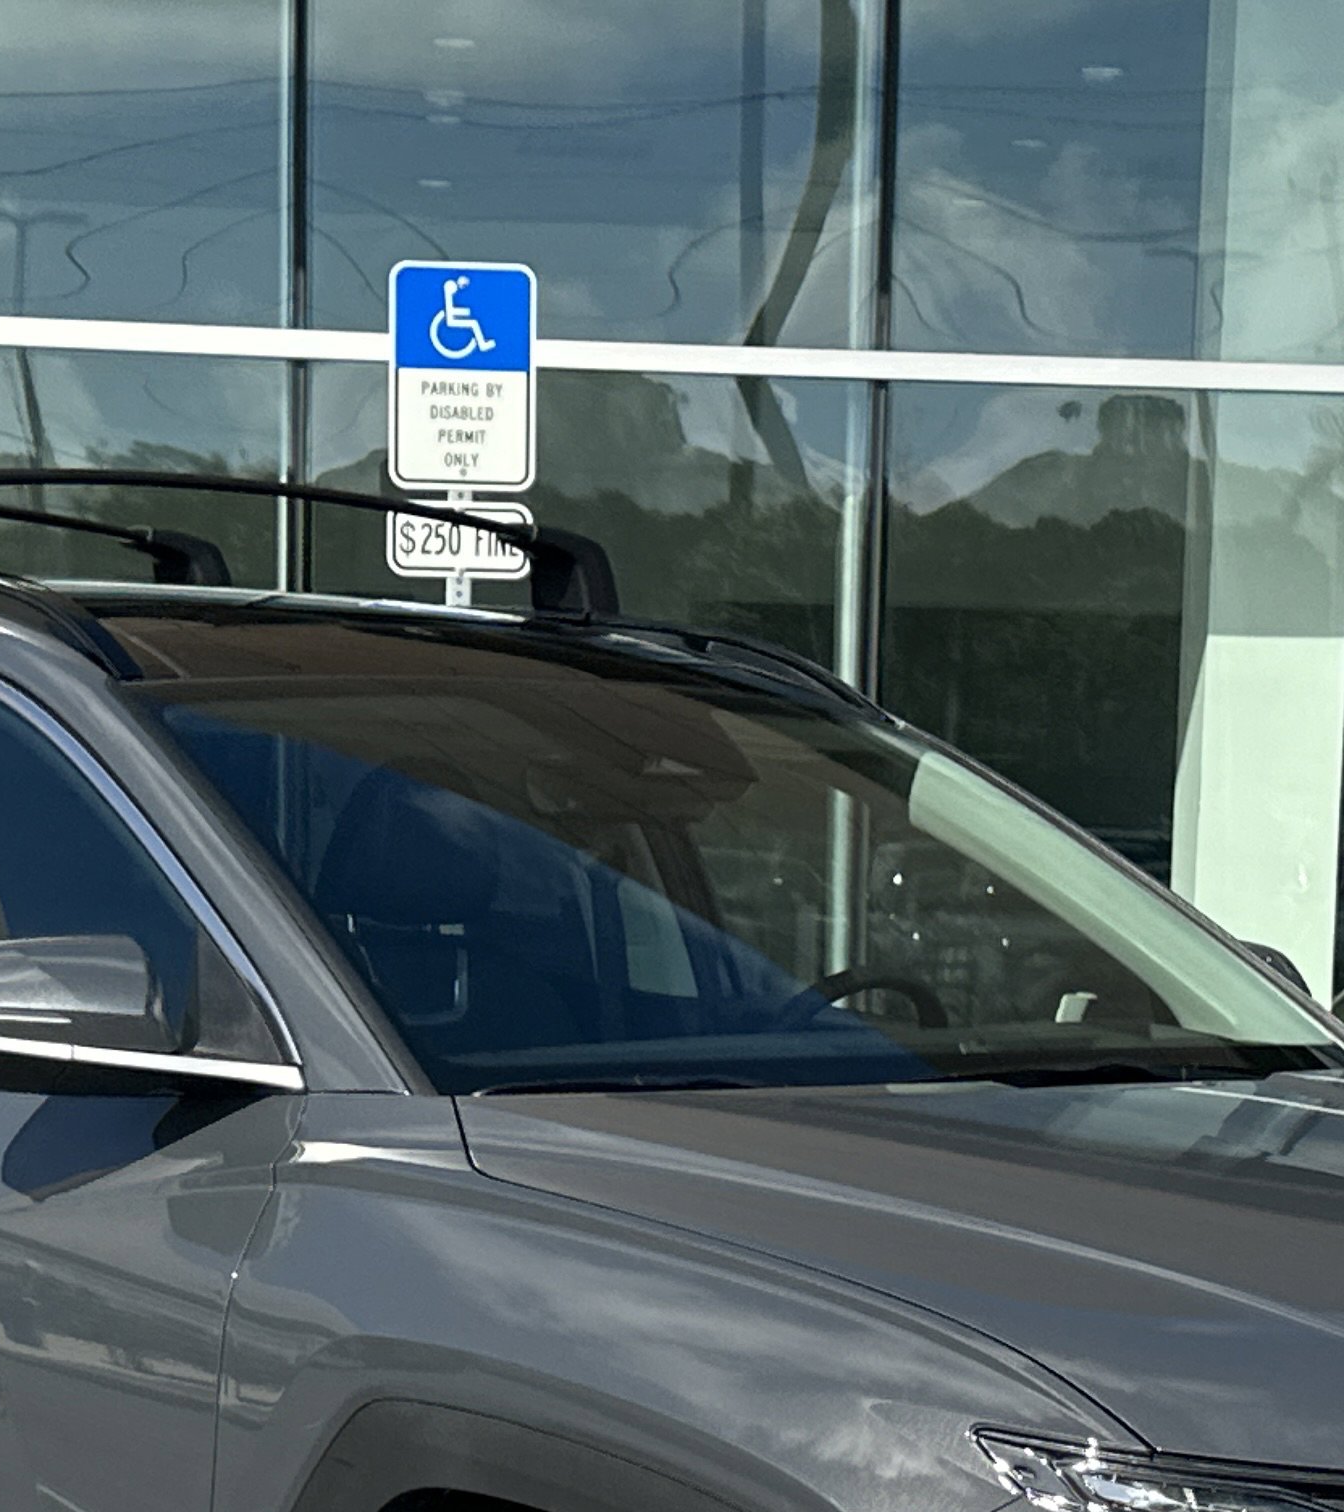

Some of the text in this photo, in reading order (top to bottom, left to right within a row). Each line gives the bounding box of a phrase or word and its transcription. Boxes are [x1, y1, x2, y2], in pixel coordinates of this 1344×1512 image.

[421, 381, 503, 398] PARKING BY
[430, 404, 494, 421] DISABLED
[438, 429, 486, 444] PERMIT
[444, 452, 479, 467] ONLY
[399, 520, 461, 558] $250
